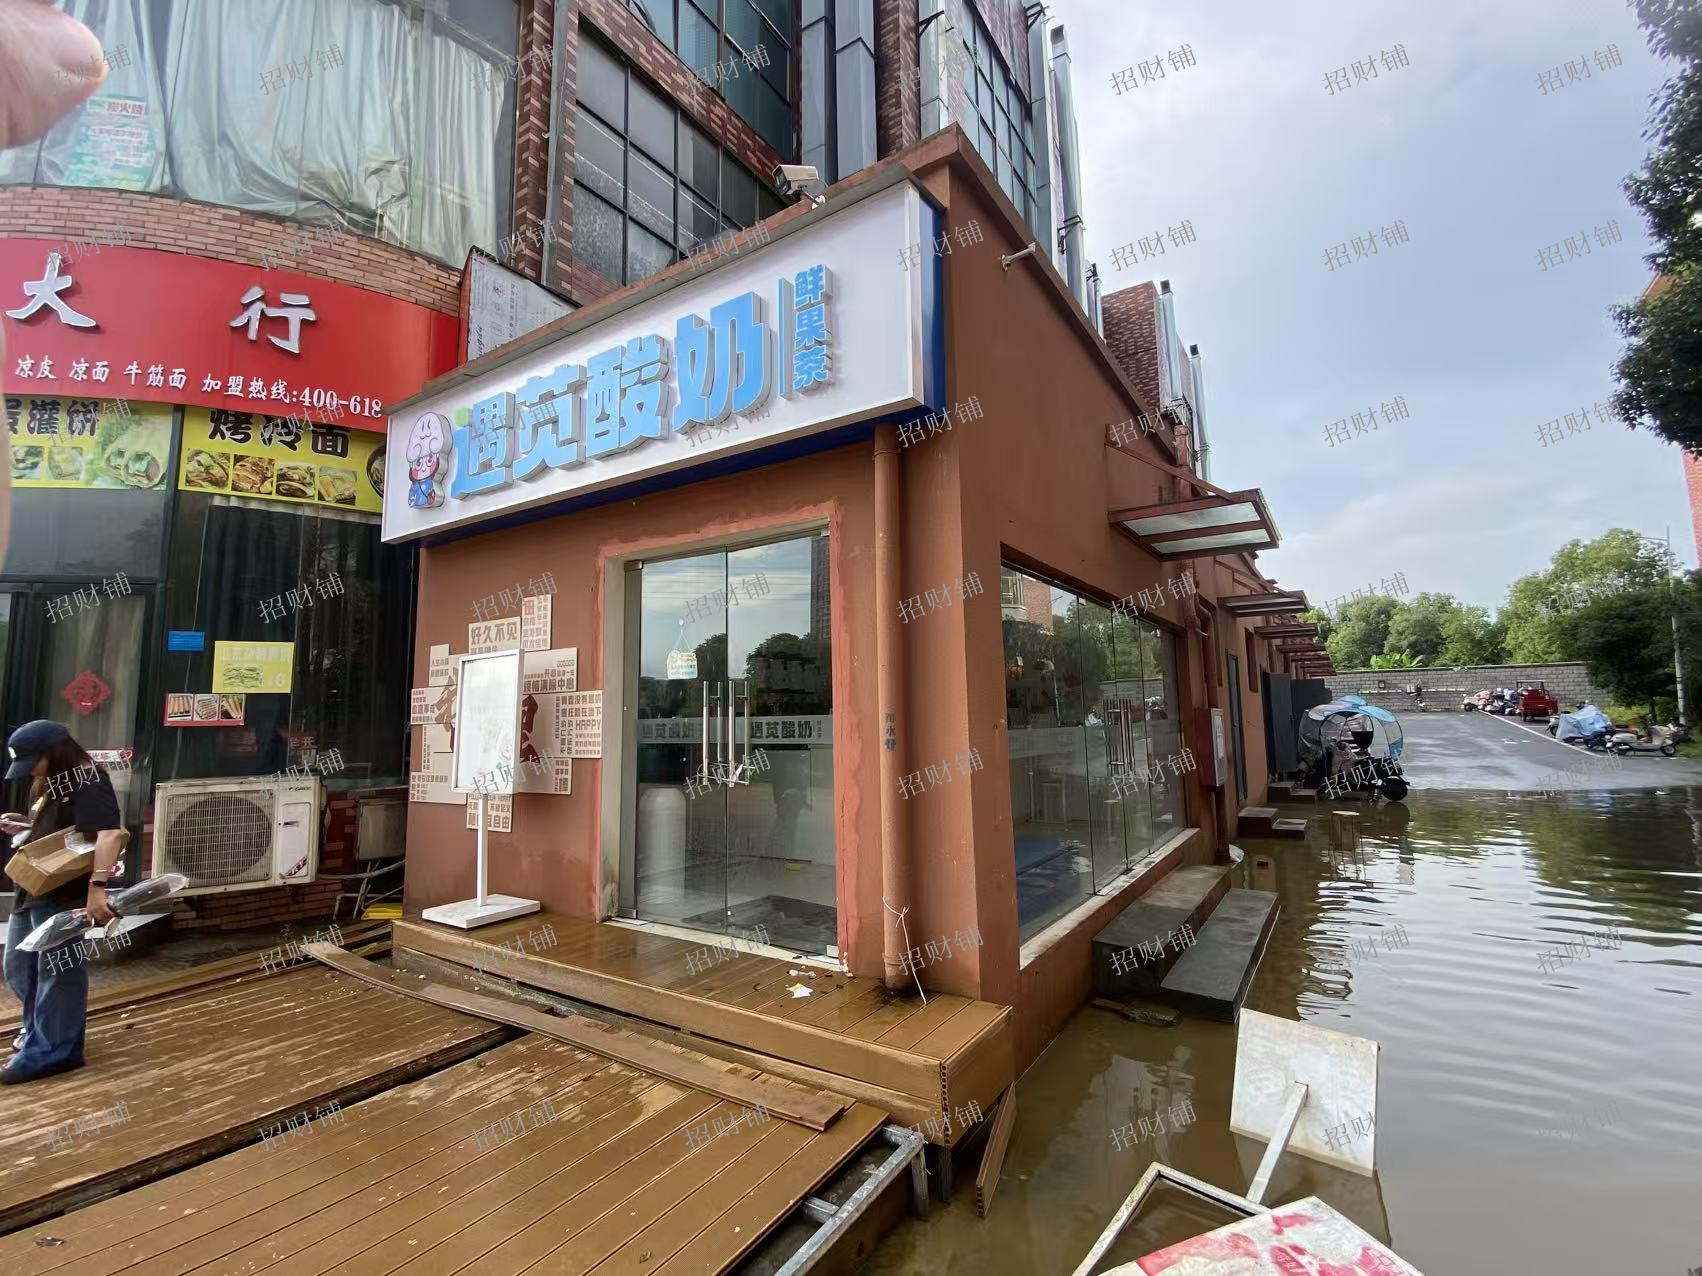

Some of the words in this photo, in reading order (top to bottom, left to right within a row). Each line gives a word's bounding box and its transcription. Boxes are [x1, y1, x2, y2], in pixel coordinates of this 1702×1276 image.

[5, 252, 97, 328] 大
[229, 285, 318, 354] 行
[793, 264, 832, 390] 鲜果茶
[15, 354, 56, 380] 凉皮
[69, 357, 110, 383] 凉面
[122, 363, 188, 391] 牛筋面
[208, 409, 350, 458] 烤冷面
[471, 621, 518, 645] 好久不见
[575, 719, 602, 731] HAPPY
